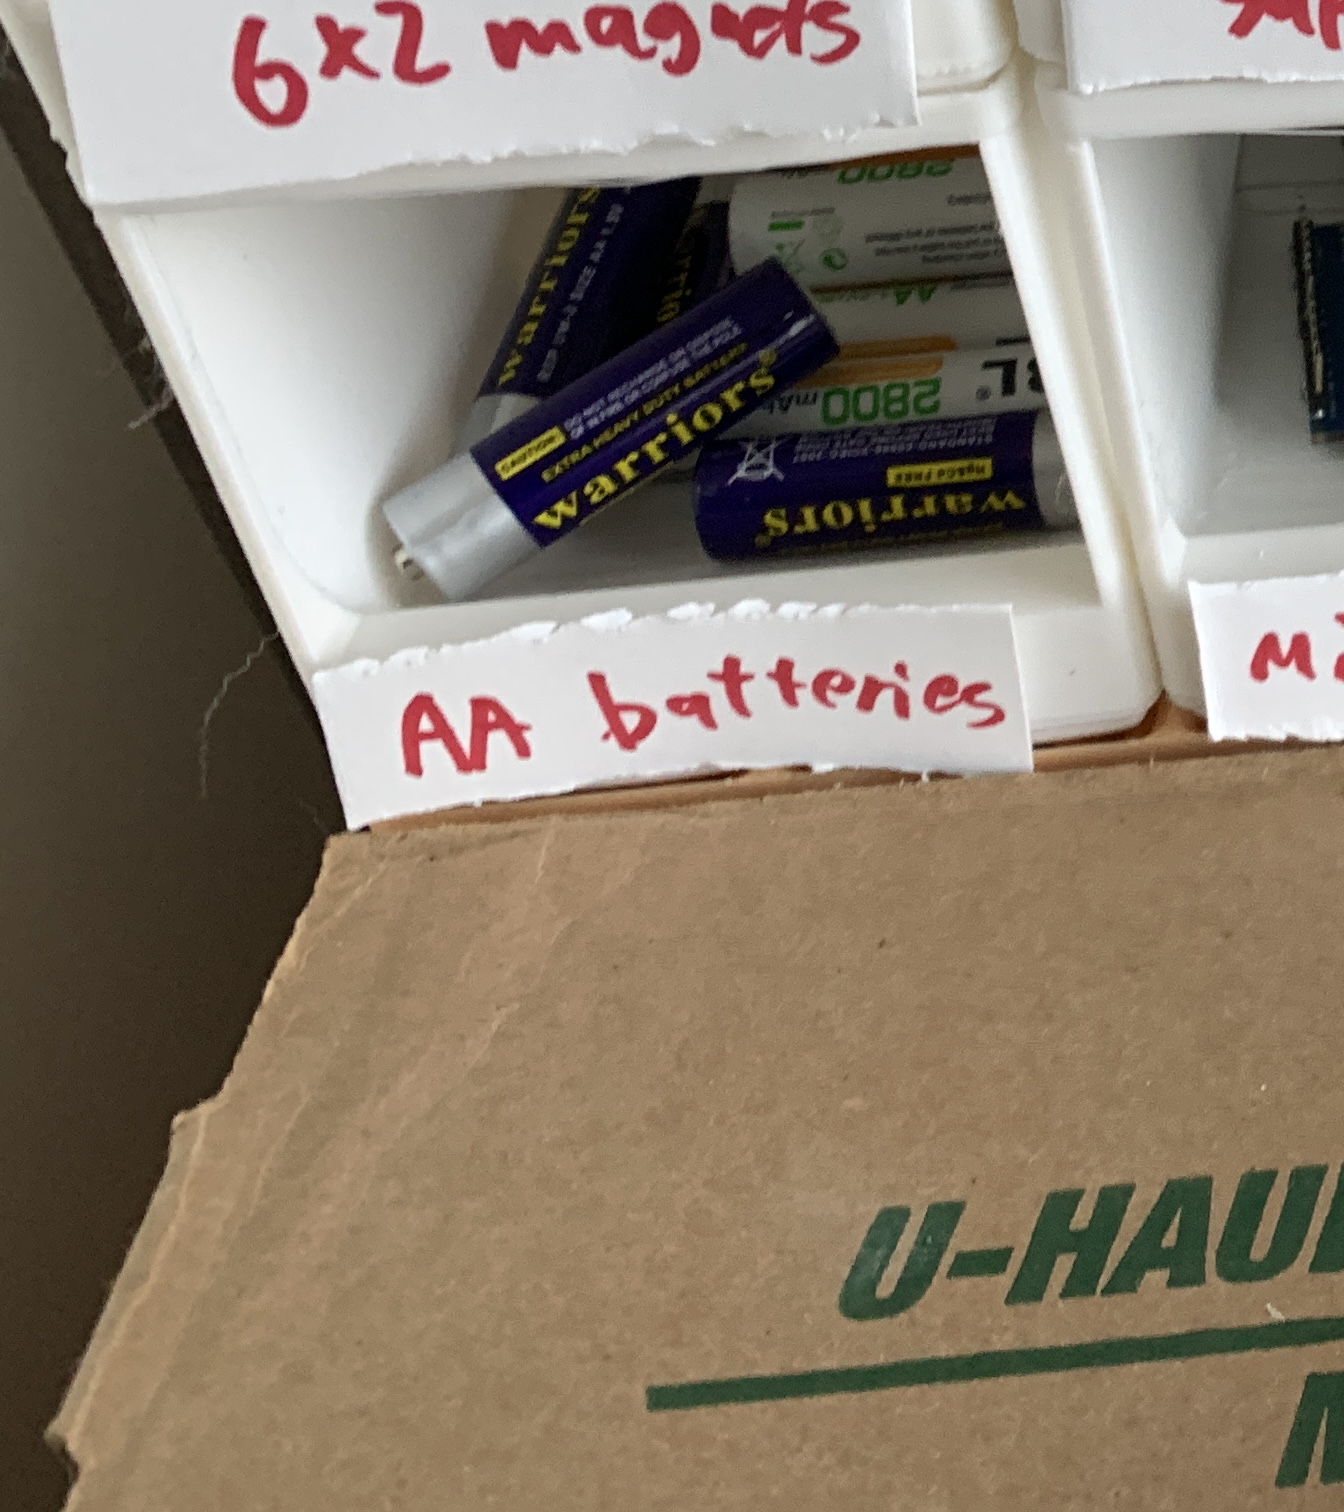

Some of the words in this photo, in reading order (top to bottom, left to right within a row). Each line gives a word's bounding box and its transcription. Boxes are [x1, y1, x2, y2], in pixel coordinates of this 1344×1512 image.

[498, 188, 600, 385] warriors
[534, 364, 776, 531] warriors
[818, 376, 943, 426] 2800
[761, 489, 1026, 537] warriors
[401, 693, 531, 776] AA
[588, 654, 1006, 751] batteries
